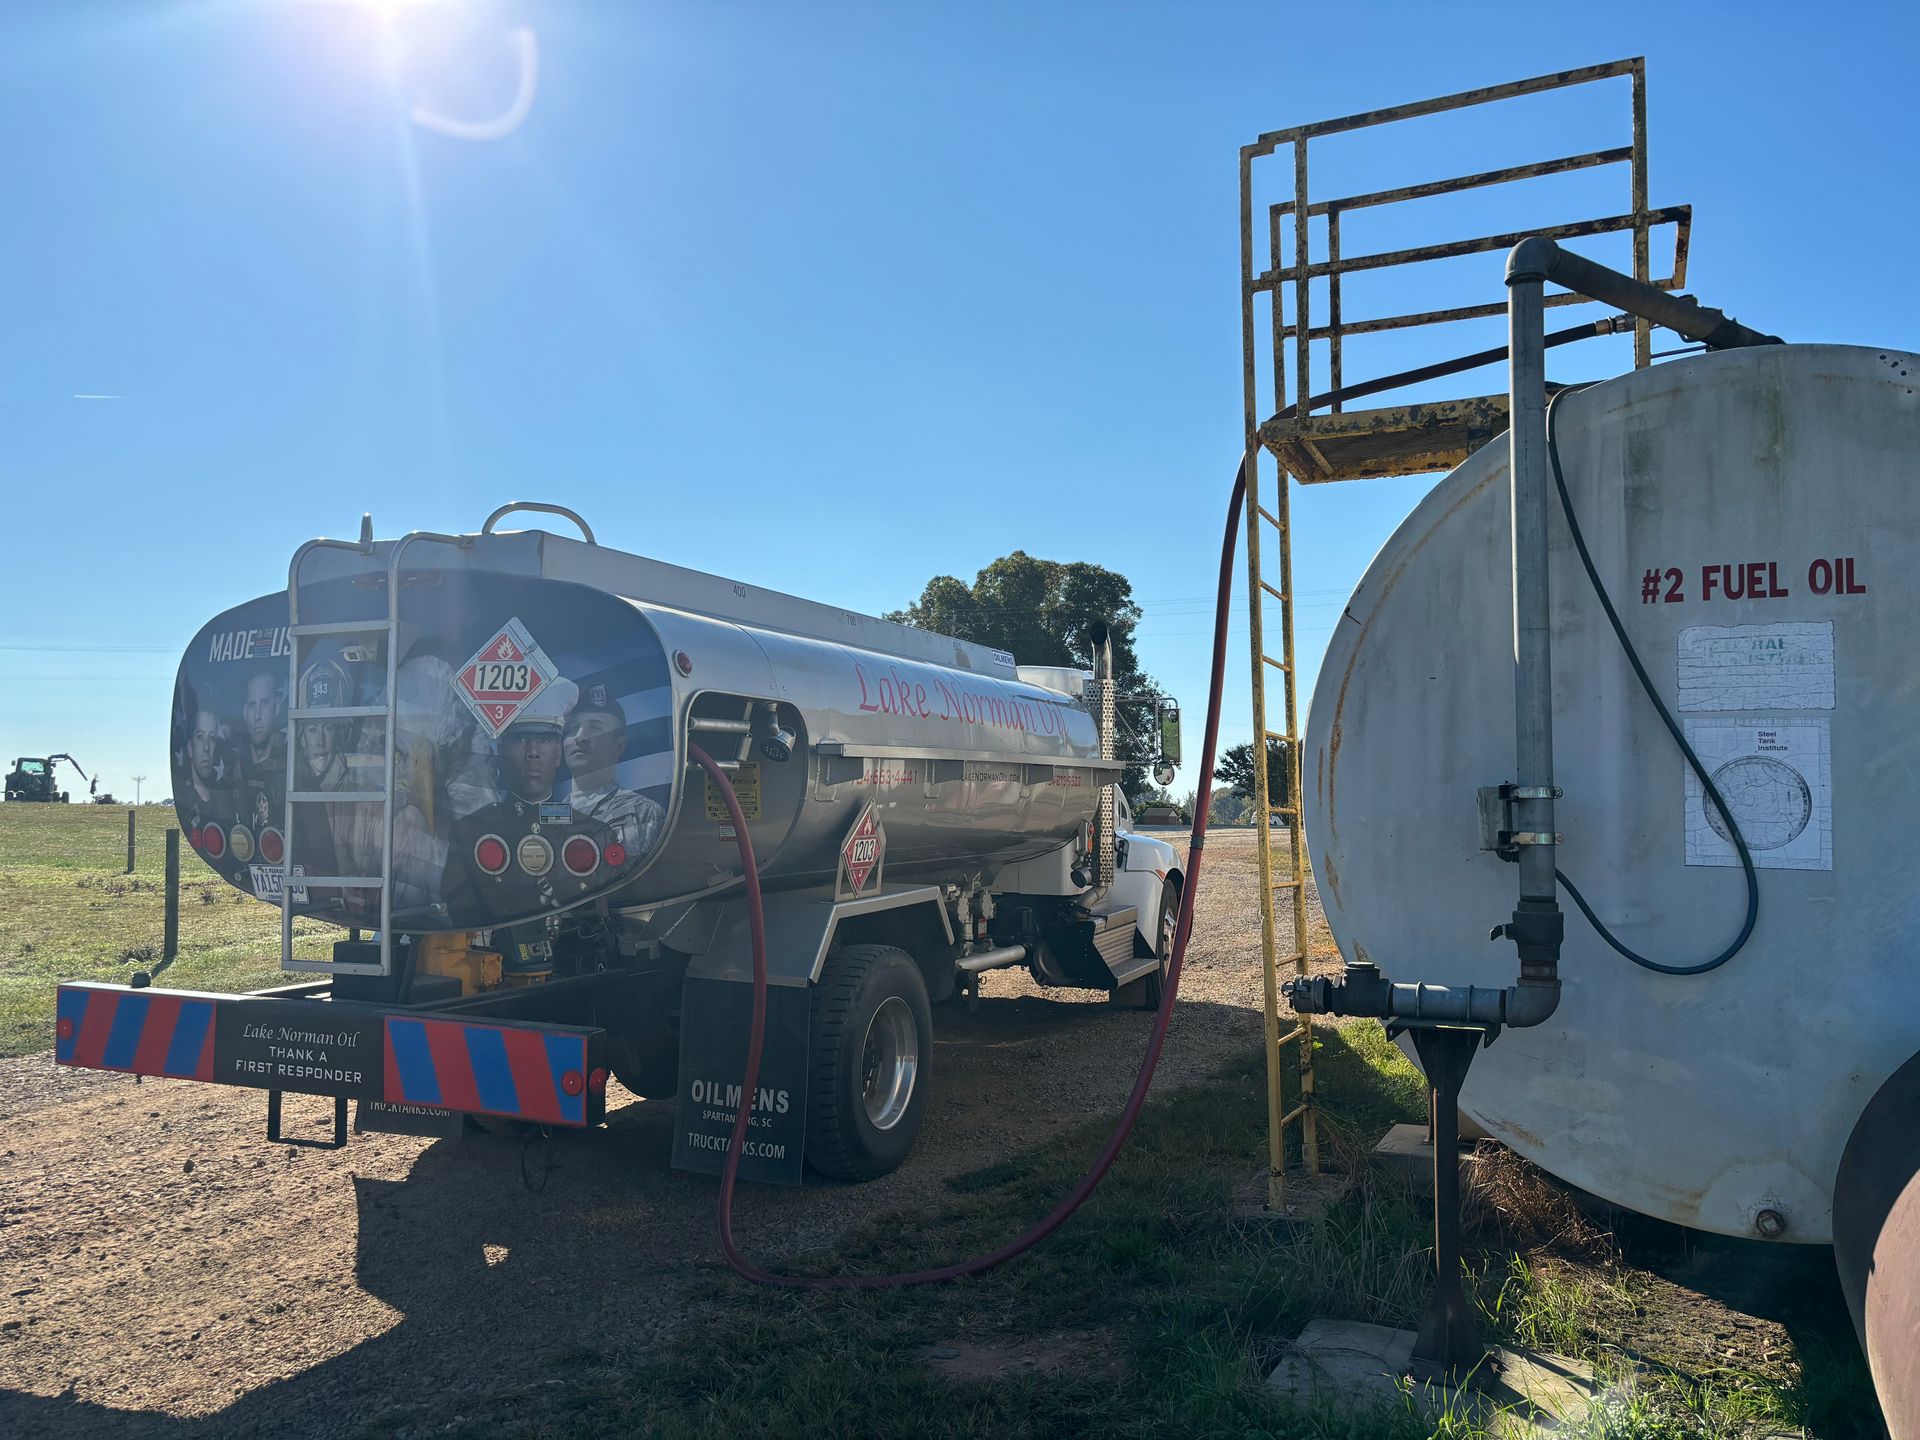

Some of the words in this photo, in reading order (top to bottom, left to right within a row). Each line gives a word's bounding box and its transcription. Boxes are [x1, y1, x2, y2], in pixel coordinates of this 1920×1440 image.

[1641, 567, 1685, 605] #2
[1702, 561, 1789, 602] FUEL
[1807, 557, 1867, 597] OIL
[732, 584, 746, 599] 400
[208, 629, 257, 663] MADE
[478, 663, 529, 691] 1203
[312, 682, 328, 697] 343
[854, 662, 931, 720] Lake
[934, 678, 1037, 733] Norman
[1036, 698, 1070, 738] Oil
[494, 705, 504, 720] 3
[1757, 730, 1777, 738] Steel
[1758, 737, 1776, 745] Tank
[1757, 744, 1789, 752] Institute
[854, 840, 875, 863] 1203
[858, 867, 864, 878] 3
[242, 1023, 274, 1040] Lake
[276, 1026, 334, 1046] Norman
[337, 1031, 361, 1048] Oil
[269, 1046, 314, 1062] THANK
[318, 1050, 328, 1063] A
[235, 1059, 273, 1074] FIRST
[277, 1063, 362, 1084] RESPONDER
[690, 1079, 790, 1114] OILMNS
[761, 1117, 772, 1128] SC
